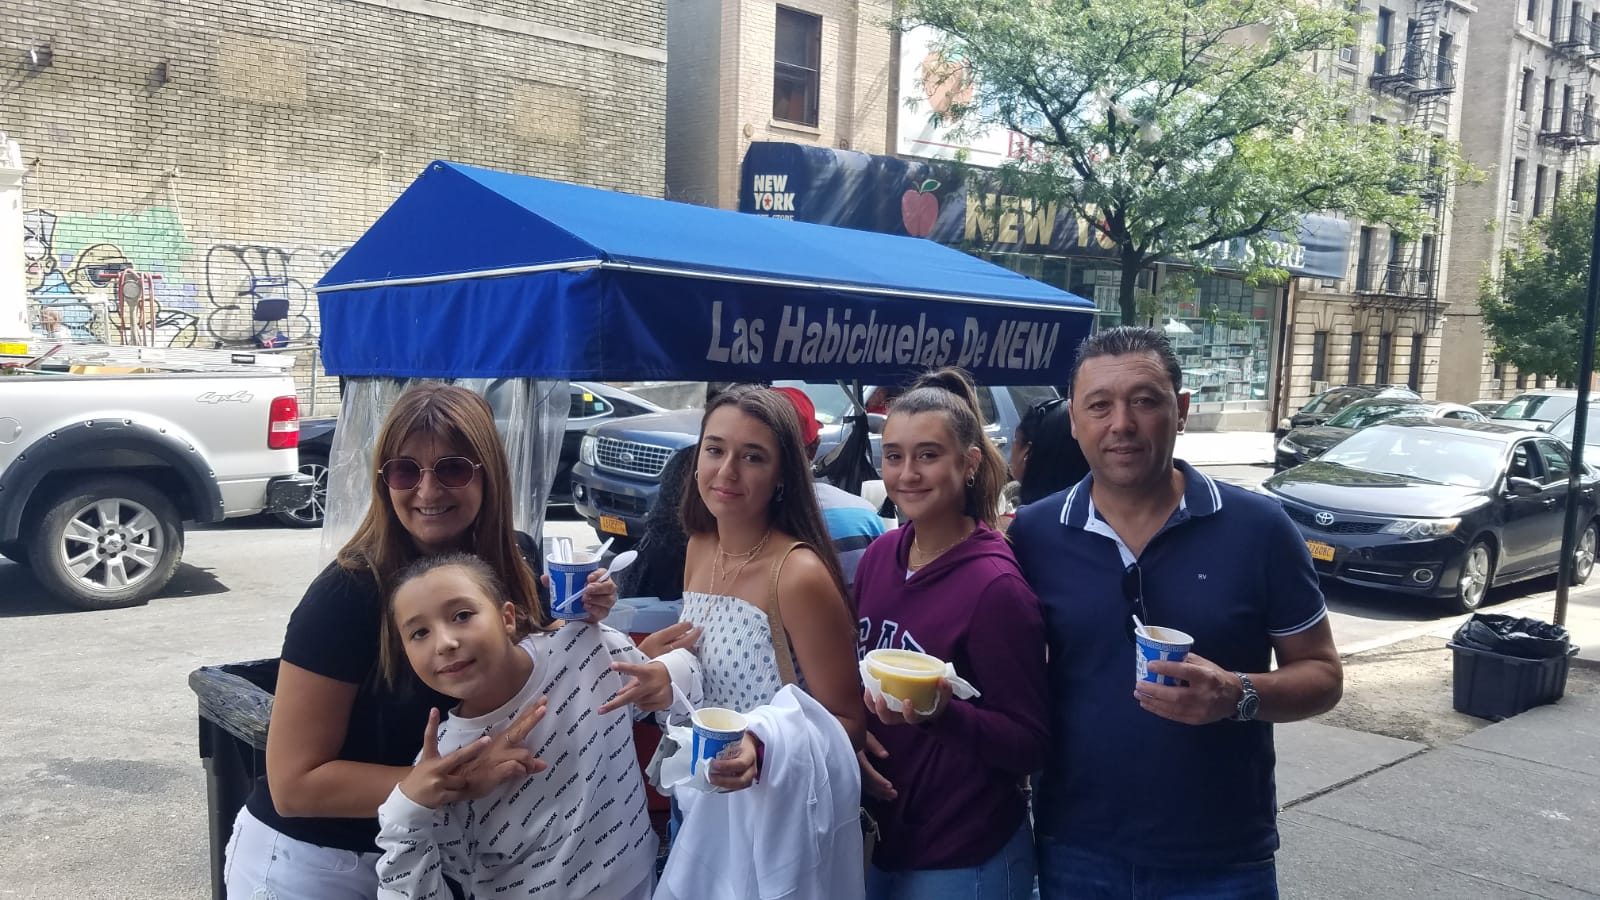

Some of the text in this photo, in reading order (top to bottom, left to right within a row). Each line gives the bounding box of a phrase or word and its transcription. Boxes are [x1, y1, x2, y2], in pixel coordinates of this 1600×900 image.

[754, 175, 788, 192] NEW
[754, 193, 795, 211] YORK
[965, 192, 1057, 246] NEW
[706, 301, 1060, 370] Las Habichuelas De NENA
[196, 391, 254, 404] 4x4
[565, 626, 589, 652] NEW YORK
[579, 643, 603, 671] NEW YORK
[543, 665, 568, 695] NEW YORK
[556, 685, 581, 715] NEW YORK
[567, 707, 592, 736] NEW YORK
[555, 750, 569, 766] YORK
[520, 776, 534, 792] YORK
[555, 771, 579, 798] NEW YORK
[565, 806, 577, 820] NEW
[600, 797, 615, 811] YORK
[498, 821, 510, 836] YORK
[595, 820, 623, 845] NEW YORK
[603, 856, 616, 869] NEW
[566, 860, 593, 887] NEW YORK
[509, 879, 524, 889] YORK
[528, 878, 557, 895] NEW YORK
